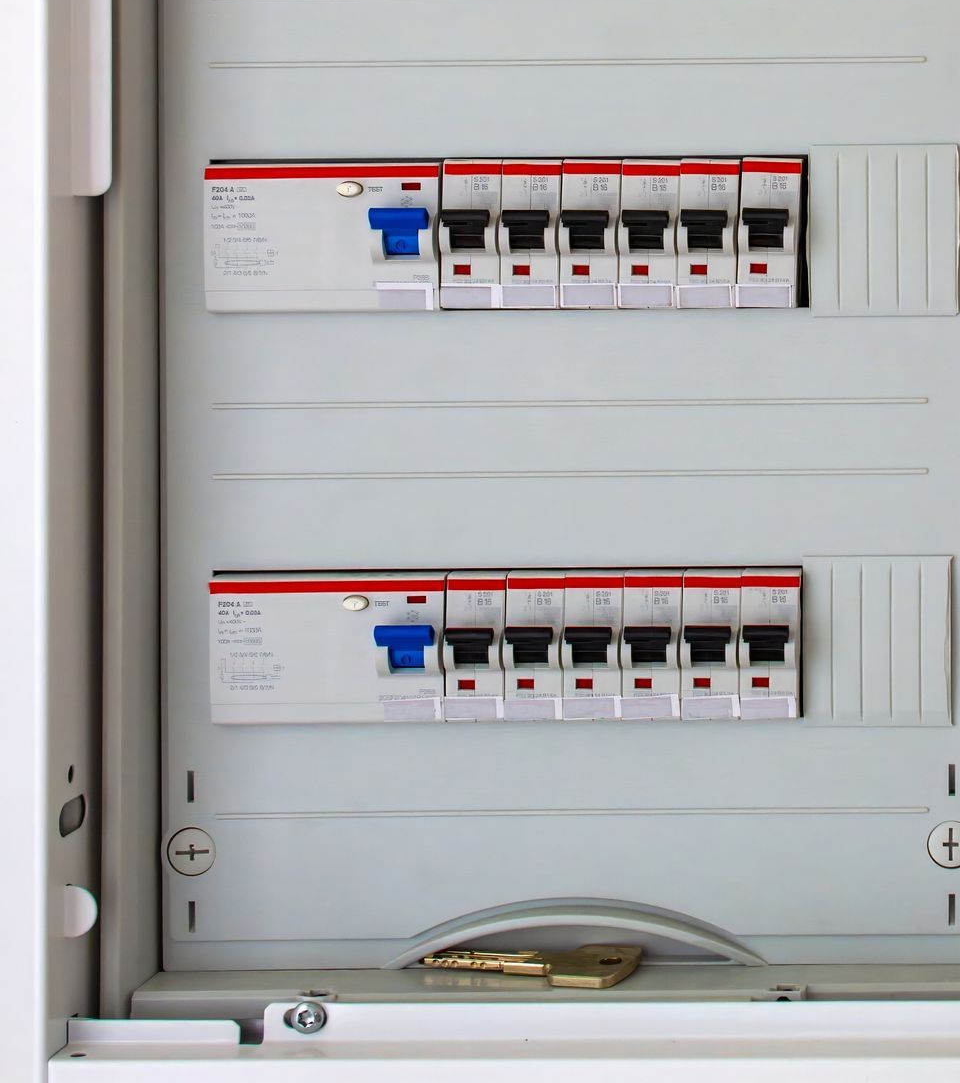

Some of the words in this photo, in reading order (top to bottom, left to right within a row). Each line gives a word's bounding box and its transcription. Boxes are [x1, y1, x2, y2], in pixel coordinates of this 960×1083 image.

[711, 183, 718, 191] B
[718, 183, 726, 191] 16
[772, 182, 779, 190] B
[779, 182, 787, 190] 16
[477, 598, 484, 606] B
[484, 598, 492, 606] 16
[537, 598, 543, 606] B
[544, 598, 551, 606] 16
[654, 597, 660, 605] B
[661, 597, 669, 605] 16
[772, 596, 779, 604] B
[779, 596, 787, 604] 16
